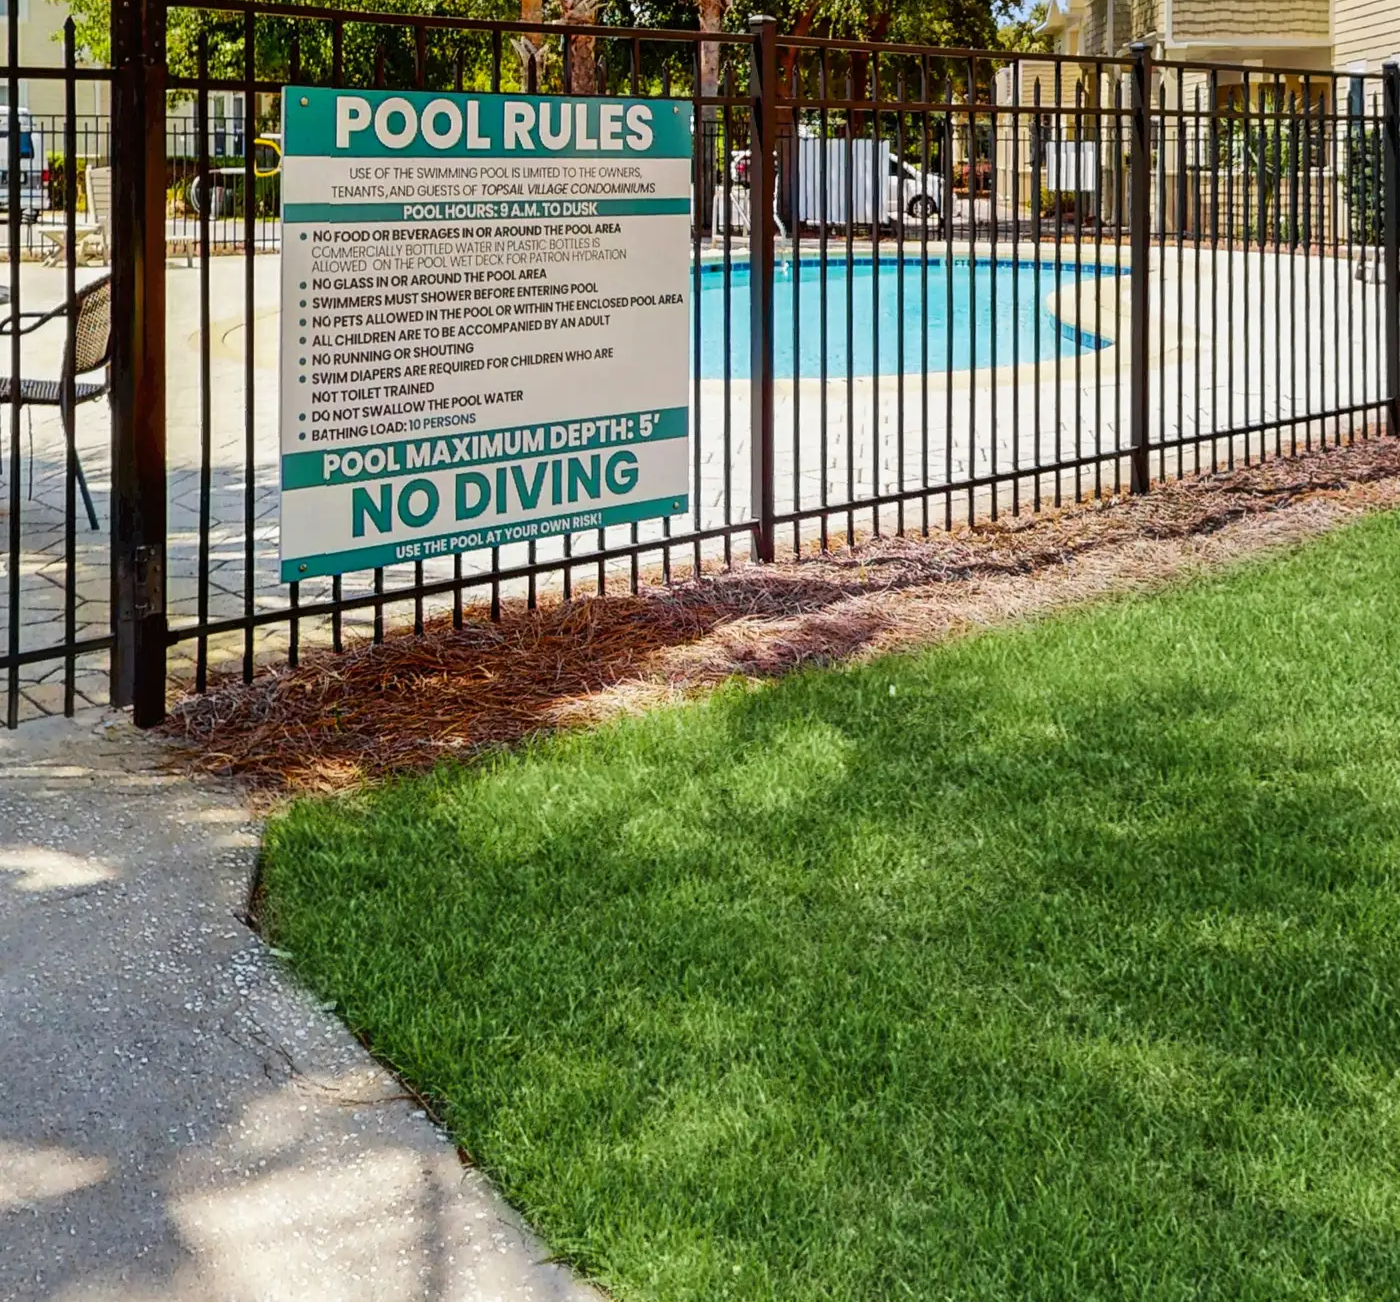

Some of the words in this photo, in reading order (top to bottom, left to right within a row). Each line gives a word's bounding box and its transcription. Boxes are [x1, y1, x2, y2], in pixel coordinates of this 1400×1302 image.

[336, 96, 490, 149] POOL
[504, 101, 653, 151] RULES
[350, 168, 371, 179] USE
[374, 168, 390, 179] OF
[394, 167, 414, 179] THE
[417, 167, 477, 178] SWIMMING
[480, 167, 509, 178] POOL
[512, 167, 520, 178] IS
[523, 167, 560, 178] LIMITED
[563, 167, 576, 178] TO
[579, 167, 597, 178] THE
[599, 167, 642, 180] OWNERS,
[332, 185, 389, 199] TENANTS,
[390, 185, 414, 197] AND
[417, 185, 460, 196] GUESTS
[463, 184, 477, 196] OF
[482, 183, 524, 196] TOPSAIL
[528, 183, 567, 195] VILLAGE
[571, 183, 655, 194] CONDOMINIUMS
[403, 204, 442, 219] POOL
[445, 203, 498, 218] HOURS:
[500, 203, 508, 217] 9
[511, 202, 540, 216] A.M.
[542, 202, 561, 216] TO
[563, 201, 600, 215] DUSK
[313, 230, 331, 242] NO
[334, 230, 370, 242] FOOD
[372, 230, 390, 241] OR
[392, 227, 460, 241] BEVERAGES
[462, 227, 474, 238] IN
[476, 226, 492, 238] OR
[494, 225, 542, 237] AROUND
[543, 224, 563, 235] THE
[565, 224, 593, 235] POOL
[594, 223, 621, 234] AREA
[312, 245, 402, 259] COMMERCIALLY
[405, 243, 453, 256] BOTTLED
[455, 241, 492, 254] WATER
[494, 241, 505, 252] IN
[507, 239, 546, 252] PLASTIC
[549, 238, 590, 250] BOTTLES
[592, 237, 600, 248] IS
[312, 260, 367, 273] ALLOWED
[372, 259, 391, 271] ON
[394, 258, 414, 270] THE
[417, 256, 447, 269] POOL
[450, 255, 473, 267] WET
[476, 254, 504, 266] DECK
[506, 252, 527, 265] FOR
[529, 251, 569, 263] PATRON
[572, 249, 626, 261] HYDRATION
[312, 278, 331, 290] NO
[334, 277, 373, 290] GLASS
[376, 276, 388, 288] IN
[391, 275, 408, 287] OR
[410, 273, 461, 286] AROUND
[464, 271, 484, 283] THE
[487, 269, 516, 282] POOL
[518, 268, 547, 280] AREA
[312, 295, 382, 310] SWIMMERS
[384, 292, 419, 306] MUST
[420, 289, 472, 303] SHOWER
[474, 287, 517, 300] BEFORE
[517, 284, 569, 297] ENTERING
[571, 282, 598, 294] POOL
[312, 315, 331, 328] NO
[334, 314, 363, 327] PETS
[365, 310, 424, 326] ALLOWED
[426, 309, 438, 321] IN
[440, 308, 461, 320] THE
[464, 306, 494, 318] POOL
[496, 304, 512, 316] OR
[513, 302, 553, 315] WITHIN
[555, 300, 574, 312] THE
[577, 297, 629, 311] ENCLOSED
[631, 295, 656, 307] POOL
[658, 293, 683, 305] AREA
[312, 335, 332, 347] ALL
[335, 331, 396, 346] CHILDREN
[398, 329, 421, 342] ARE
[423, 327, 439, 339] TO
[442, 326, 455, 338] BE
[457, 320, 542, 337] ACCOMPANIED
[544, 318, 558, 330] BY
[560, 317, 576, 329] AN
[578, 315, 610, 327] ADULT
[312, 353, 331, 366] NO
[334, 349, 391, 365] RUNNING
[394, 348, 411, 359] OR
[413, 343, 474, 358] SHOUTING
[312, 372, 348, 385] SWIM
[350, 367, 401, 382] DIAPERS
[403, 364, 426, 377] ARE
[429, 359, 484, 375] REQUIRED
[487, 357, 509, 369] FOR
[511, 352, 563, 367] CHILDREN
[565, 350, 592, 362] WHO
[594, 348, 614, 359] ARE
[312, 391, 338, 404] NOT
[341, 387, 381, 402] TOILET
[383, 382, 434, 397] TRAINED
[312, 410, 330, 422] DO
[333, 408, 360, 421] NOT
[362, 400, 426, 418] SWALLOW
[428, 398, 449, 411] THE
[451, 395, 482, 408] POOL
[484, 390, 523, 404] WATER
[312, 425, 368, 441] BATHING
[371, 421, 407, 435] LOAD:
[409, 419, 420, 431] 10
[423, 413, 476, 429] PERSONS
[323, 447, 400, 480] POOL
[406, 427, 544, 469] MAXIMUM
[550, 417, 634, 449] DEPTH:
[352, 478, 440, 538] NO
[455, 450, 639, 522] DIVING
[396, 545, 420, 558] USE
[423, 539, 447, 554] THE
[450, 533, 484, 549] POOL
[486, 530, 502, 544] AT
[504, 524, 538, 540] YOUR
[541, 518, 570, 534] OWN
[573, 512, 602, 528] RISK!
